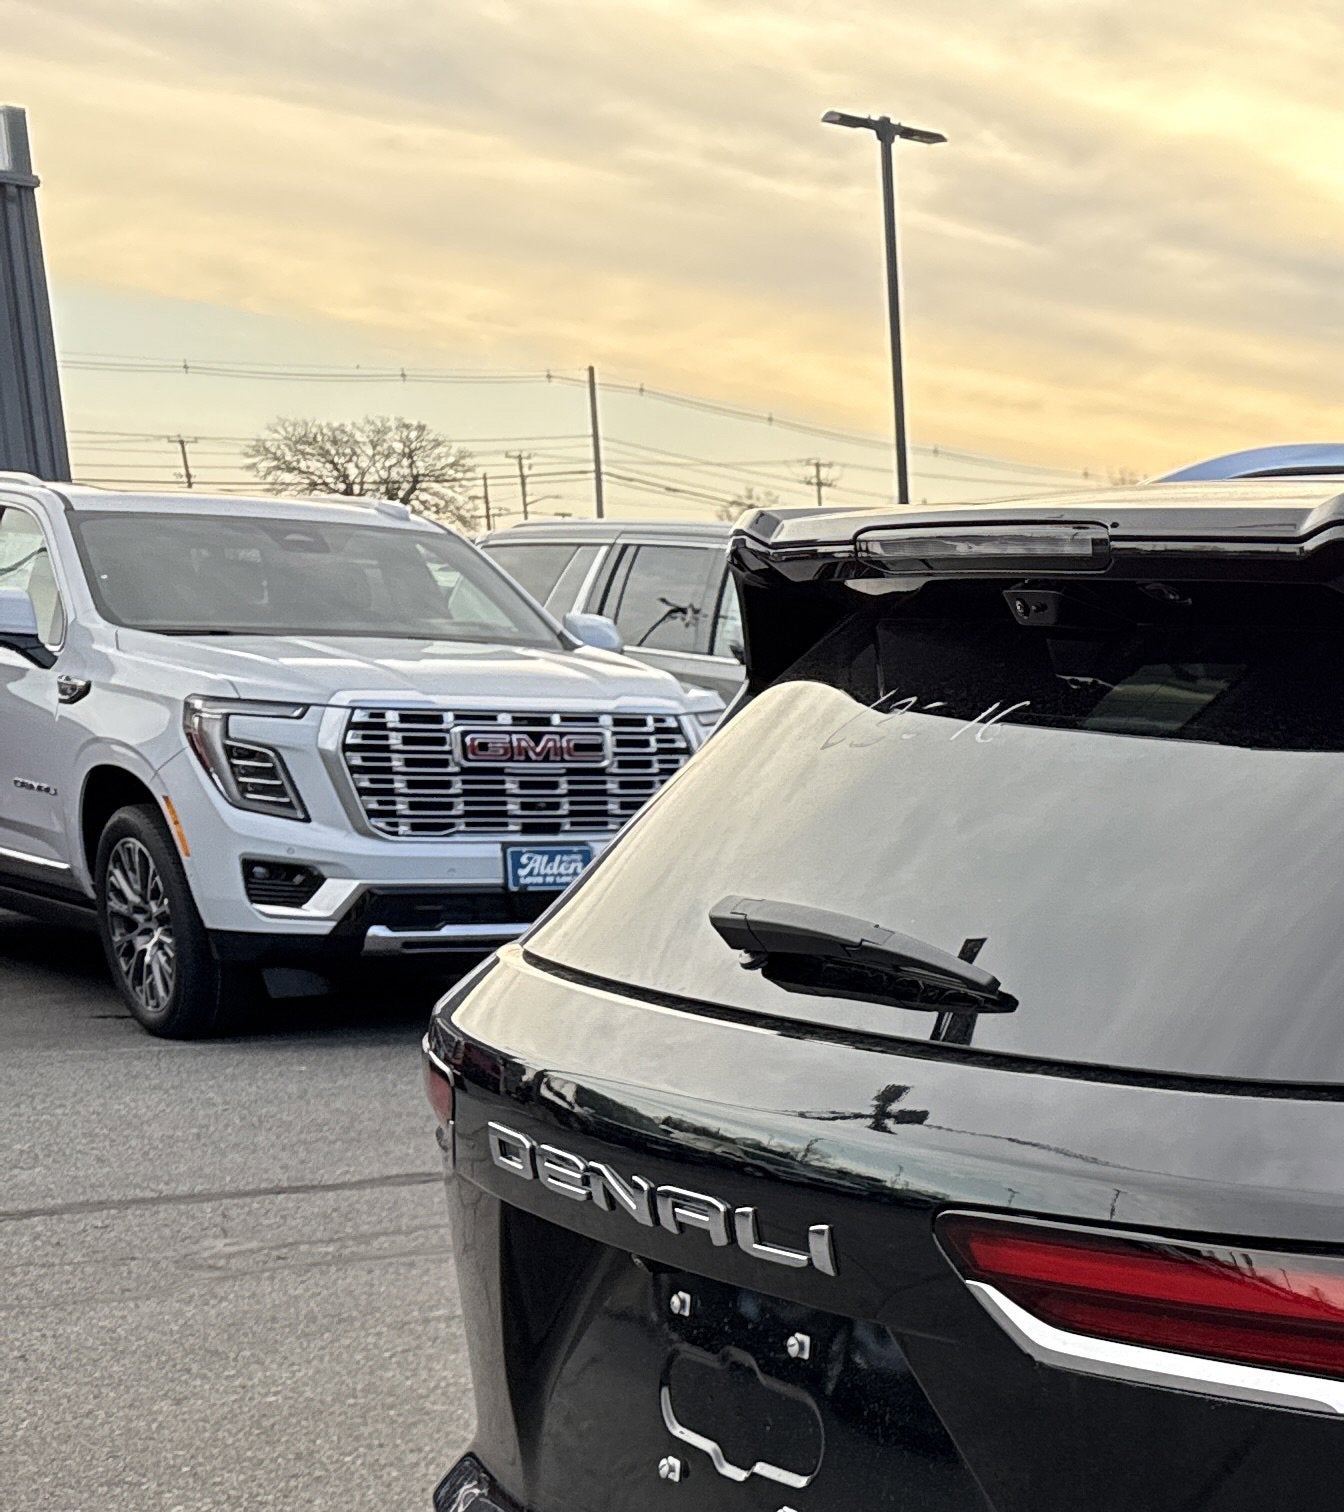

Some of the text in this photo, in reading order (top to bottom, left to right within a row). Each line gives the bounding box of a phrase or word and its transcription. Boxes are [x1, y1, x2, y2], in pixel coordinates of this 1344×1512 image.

[465, 733, 605, 761] GMC
[518, 853, 584, 876] Alden
[488, 1121, 838, 1277] DENALI
